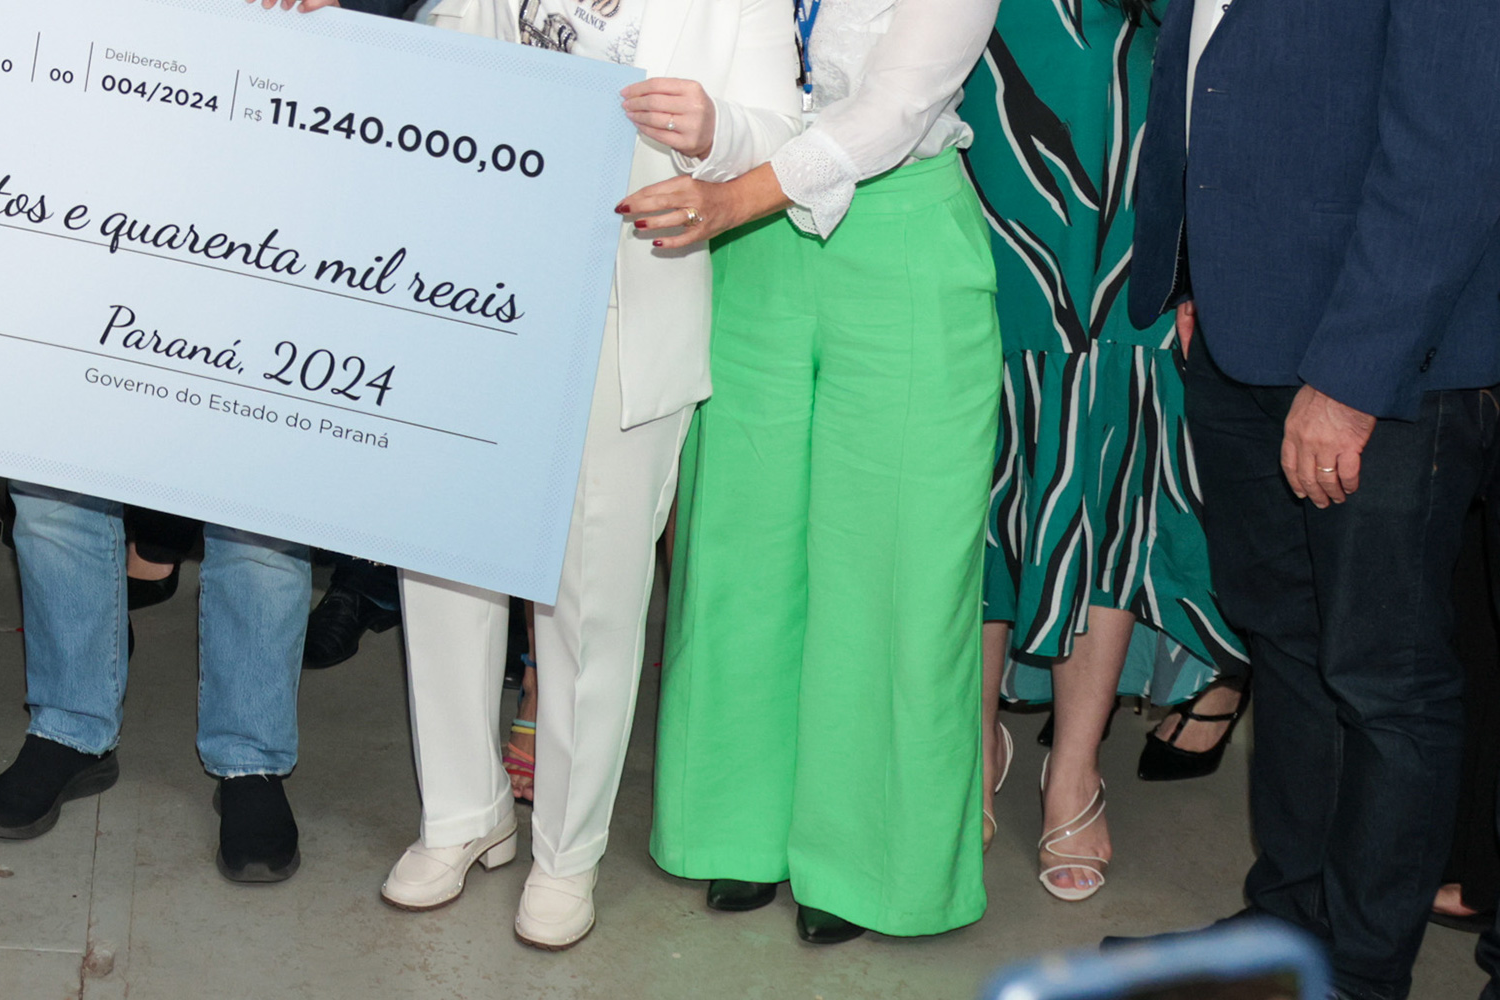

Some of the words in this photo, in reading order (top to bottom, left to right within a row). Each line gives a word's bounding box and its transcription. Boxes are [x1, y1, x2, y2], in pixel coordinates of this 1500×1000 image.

[574, 6, 607, 31] FRANCE
[0, 58, 13, 73] 0
[49, 67, 74, 85] 00
[104, 47, 187, 75] Deliberação
[101, 73, 219, 113] 004/2024
[248, 74, 285, 93] Valor
[243, 105, 263, 123] R$
[269, 97, 546, 179] 11.240.000,00
[63, 203, 91, 231] e
[100, 212, 305, 276] quarenta
[314, 247, 410, 297] mil
[408, 272, 525, 325] reais
[99, 304, 245, 375] Paraná,
[262, 340, 397, 408] 2024
[84, 366, 169, 402] Governo
[174, 384, 202, 407] do
[208, 392, 279, 425] Estado
[285, 410, 313, 433] do
[319, 417, 390, 450] Paraná
